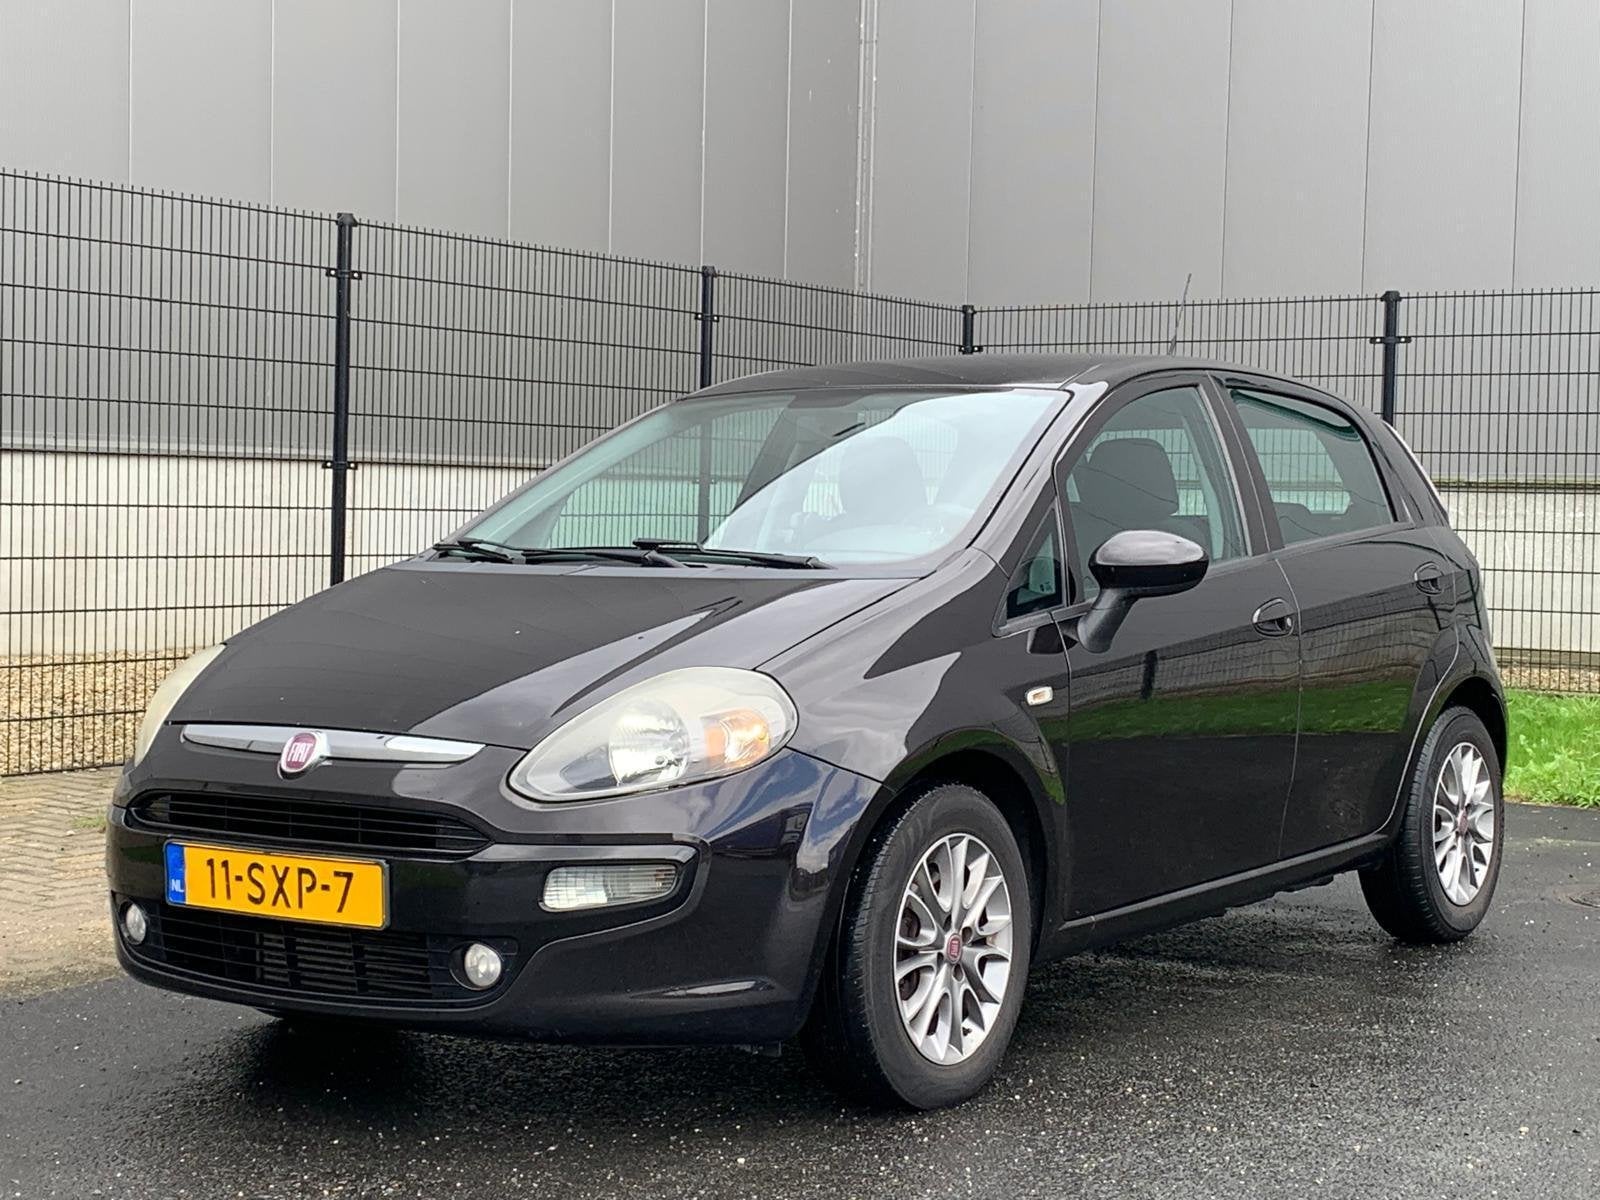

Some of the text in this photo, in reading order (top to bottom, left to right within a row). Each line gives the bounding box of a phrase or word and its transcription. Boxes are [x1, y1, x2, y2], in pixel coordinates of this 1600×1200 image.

[287, 742, 313, 762] FIAT
[171, 878, 185, 893] NL
[206, 858, 354, 913] 11-SXP-7
